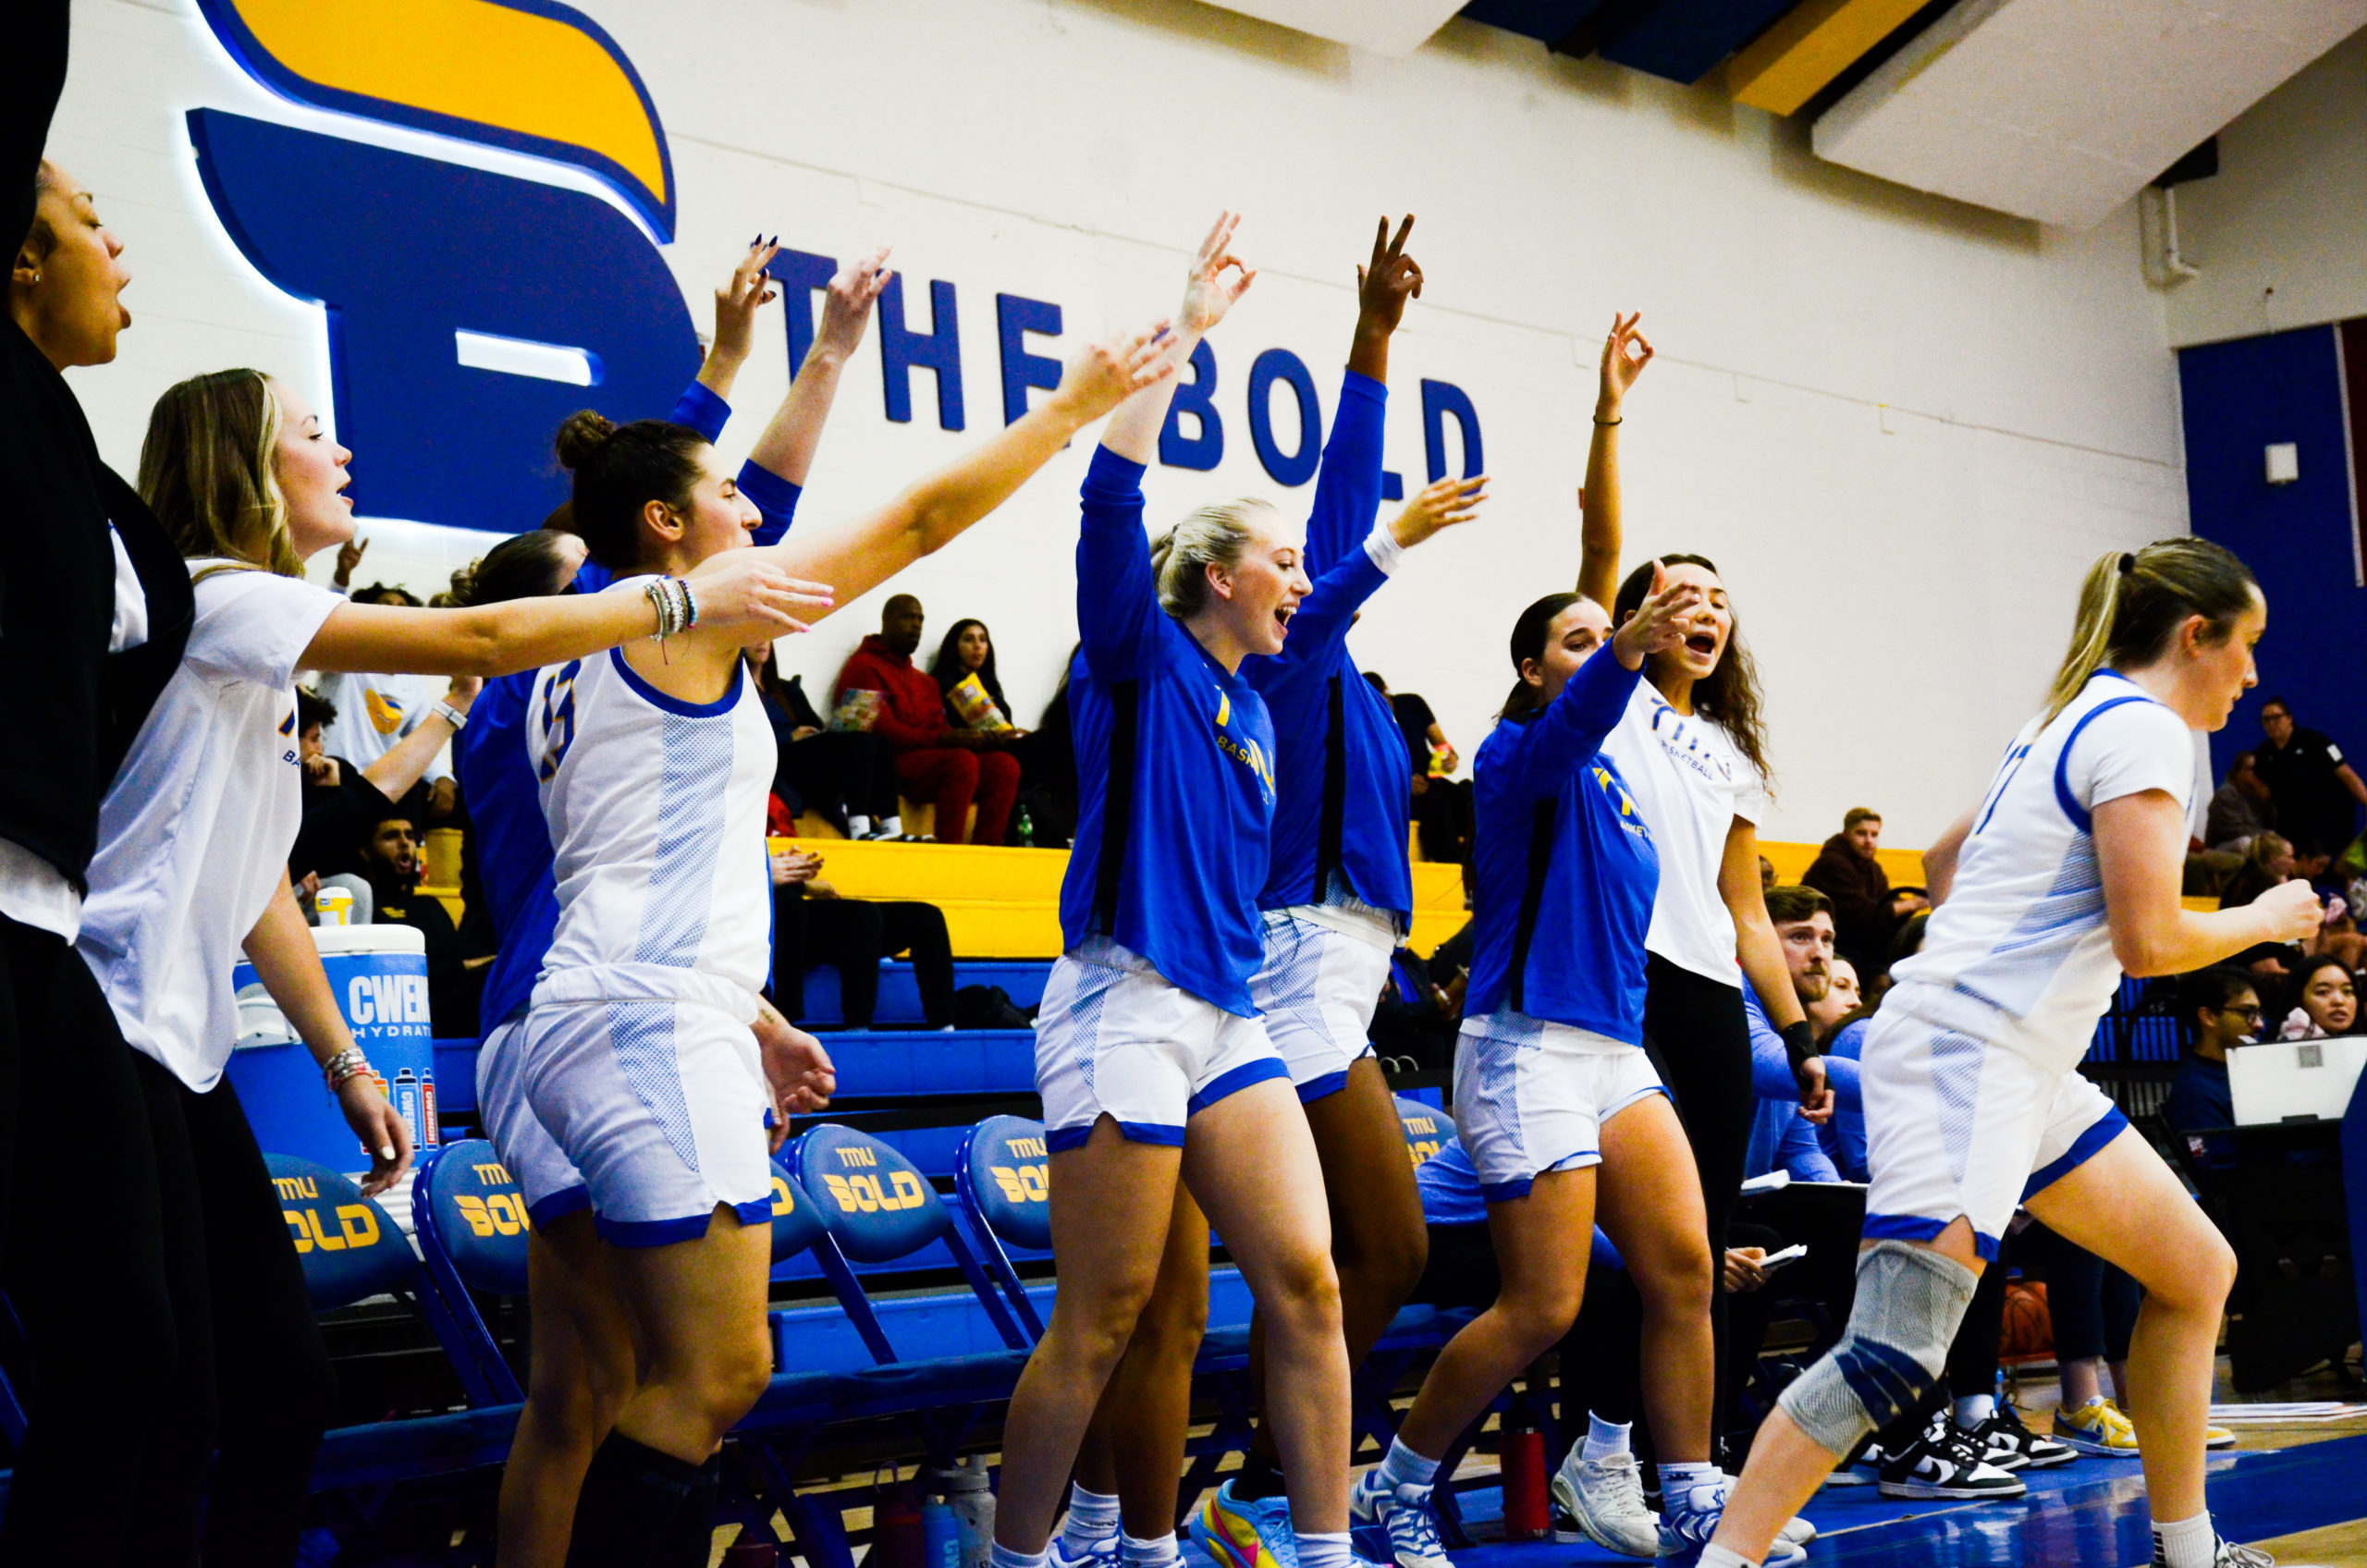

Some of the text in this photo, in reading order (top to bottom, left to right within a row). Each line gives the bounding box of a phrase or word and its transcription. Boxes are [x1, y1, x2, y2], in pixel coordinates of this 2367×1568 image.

[1156, 324, 1483, 502] BOD
[1403, 1117, 1438, 1136] TMU
[835, 1146, 877, 1168] TMU
[1005, 1137, 1049, 1158] TMU
[472, 1163, 513, 1185] TM
[822, 1170, 925, 1212] BOLD
